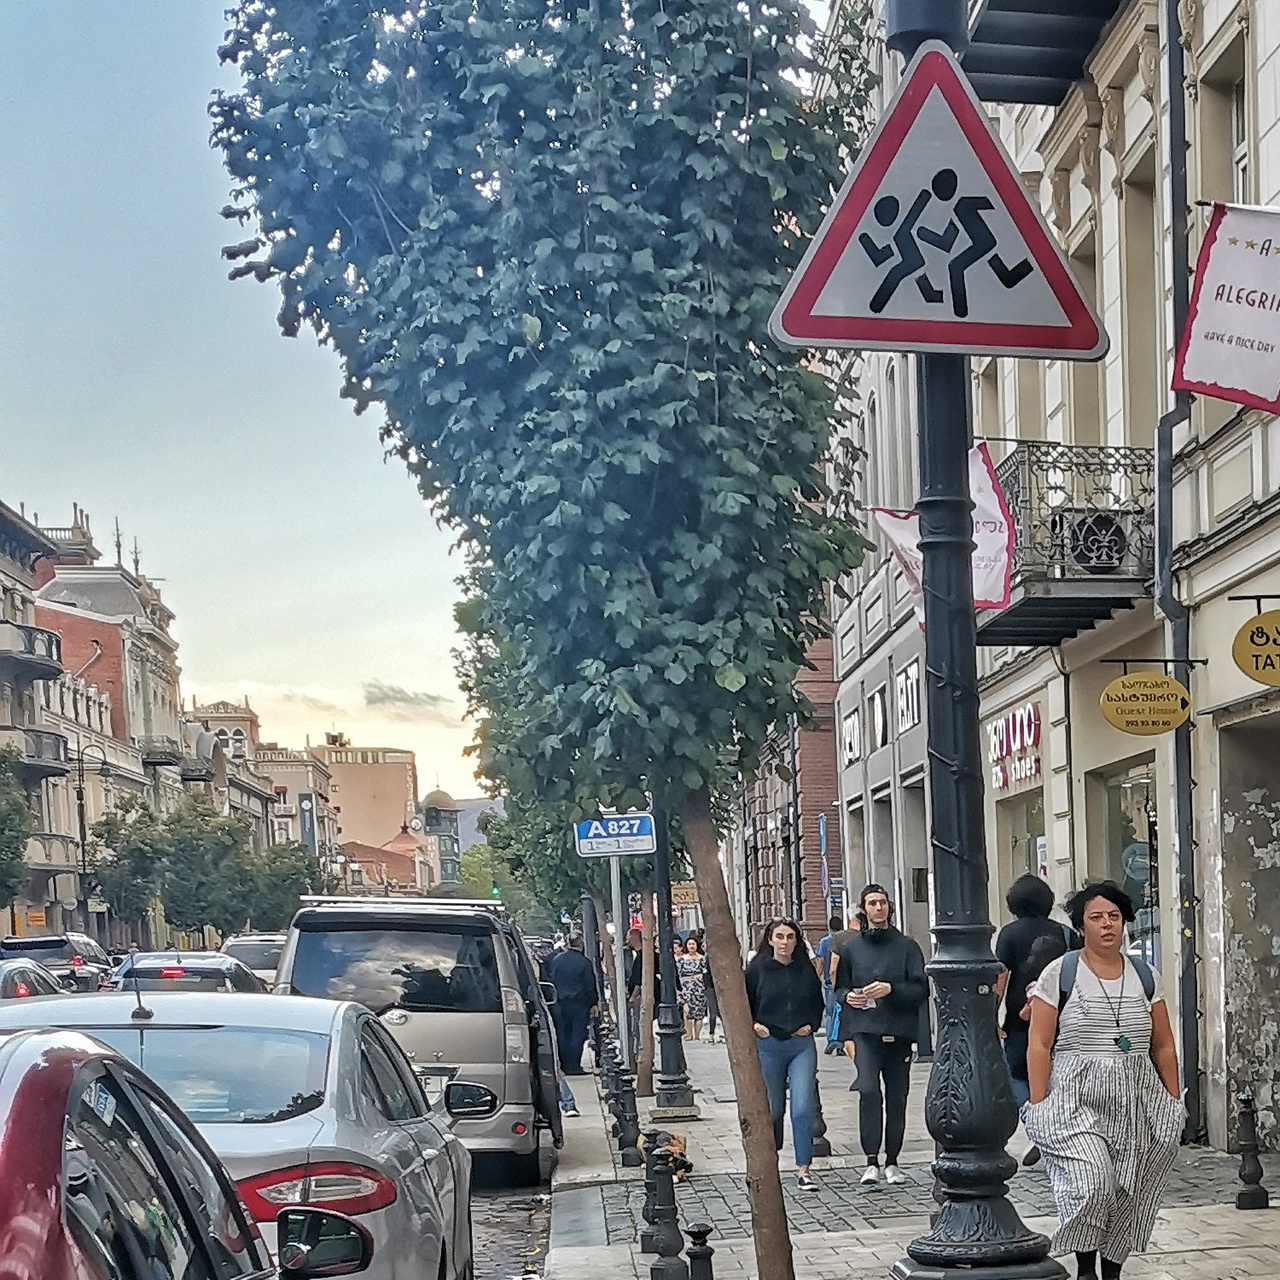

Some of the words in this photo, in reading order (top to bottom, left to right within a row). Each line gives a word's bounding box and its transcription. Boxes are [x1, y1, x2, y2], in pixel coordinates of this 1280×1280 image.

[1259, 238, 1273, 257] A
[1227, 335, 1234, 346] A
[1235, 336, 1256, 351] NICE
[1256, 341, 1277, 353] DAY
[1105, 692, 1179, 703] სასტუმრო
[1115, 706, 1146, 716] Guest
[1011, 755, 1036, 782] shoes
